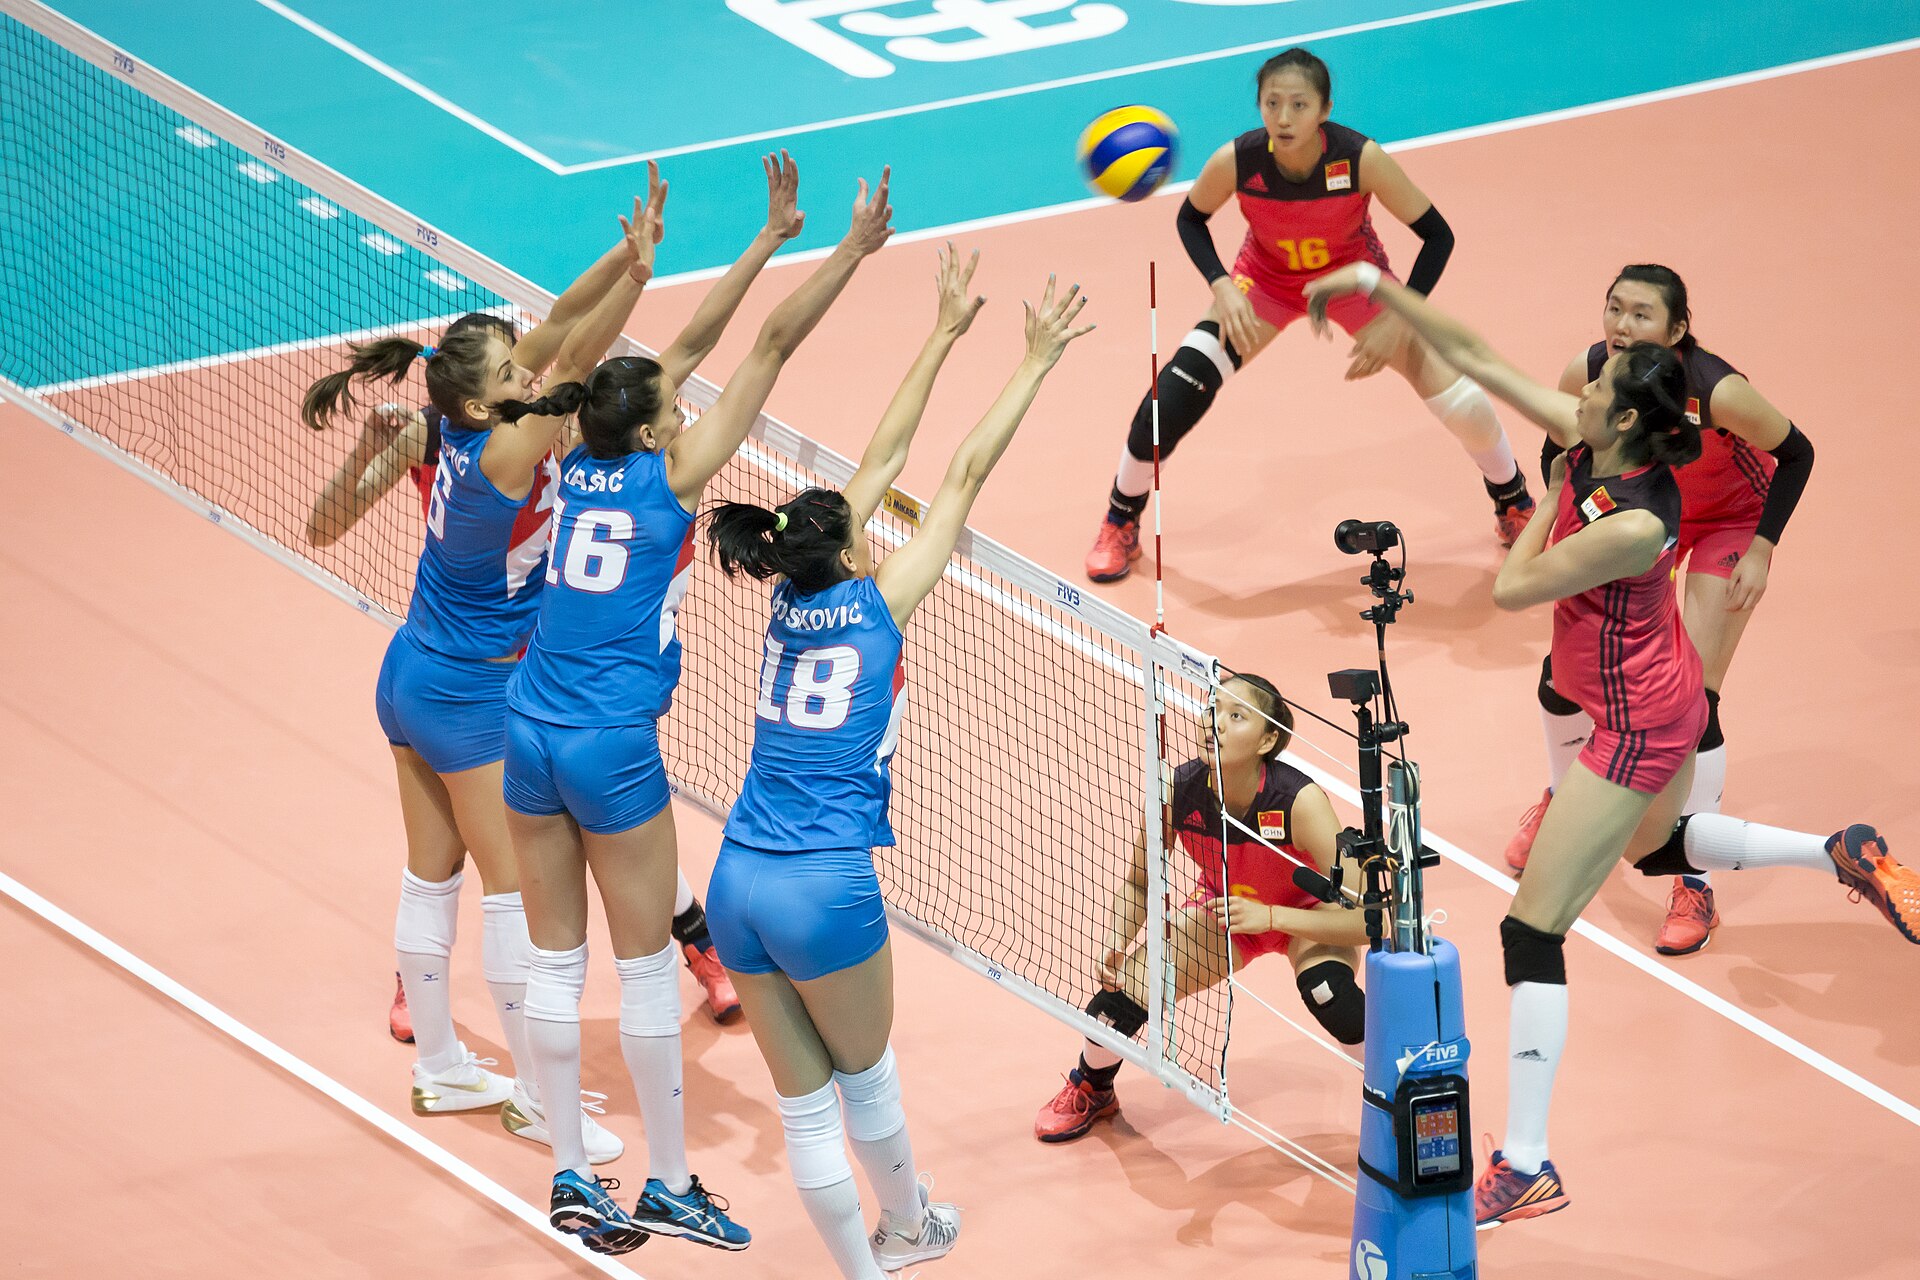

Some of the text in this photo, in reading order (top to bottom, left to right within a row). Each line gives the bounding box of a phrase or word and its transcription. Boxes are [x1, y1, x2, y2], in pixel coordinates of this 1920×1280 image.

[263, 137, 286, 160] FIVB
[415, 223, 438, 246] FIVB
[1275, 237, 1330, 271] 16
[546, 495, 632, 592] 16
[1057, 582, 1081, 606] FIVB
[756, 632, 862, 728] 18
[1263, 828, 1283, 838] CHN
[987, 966, 1002, 980] FIVB
[1426, 1044, 1458, 1062] FIVB
